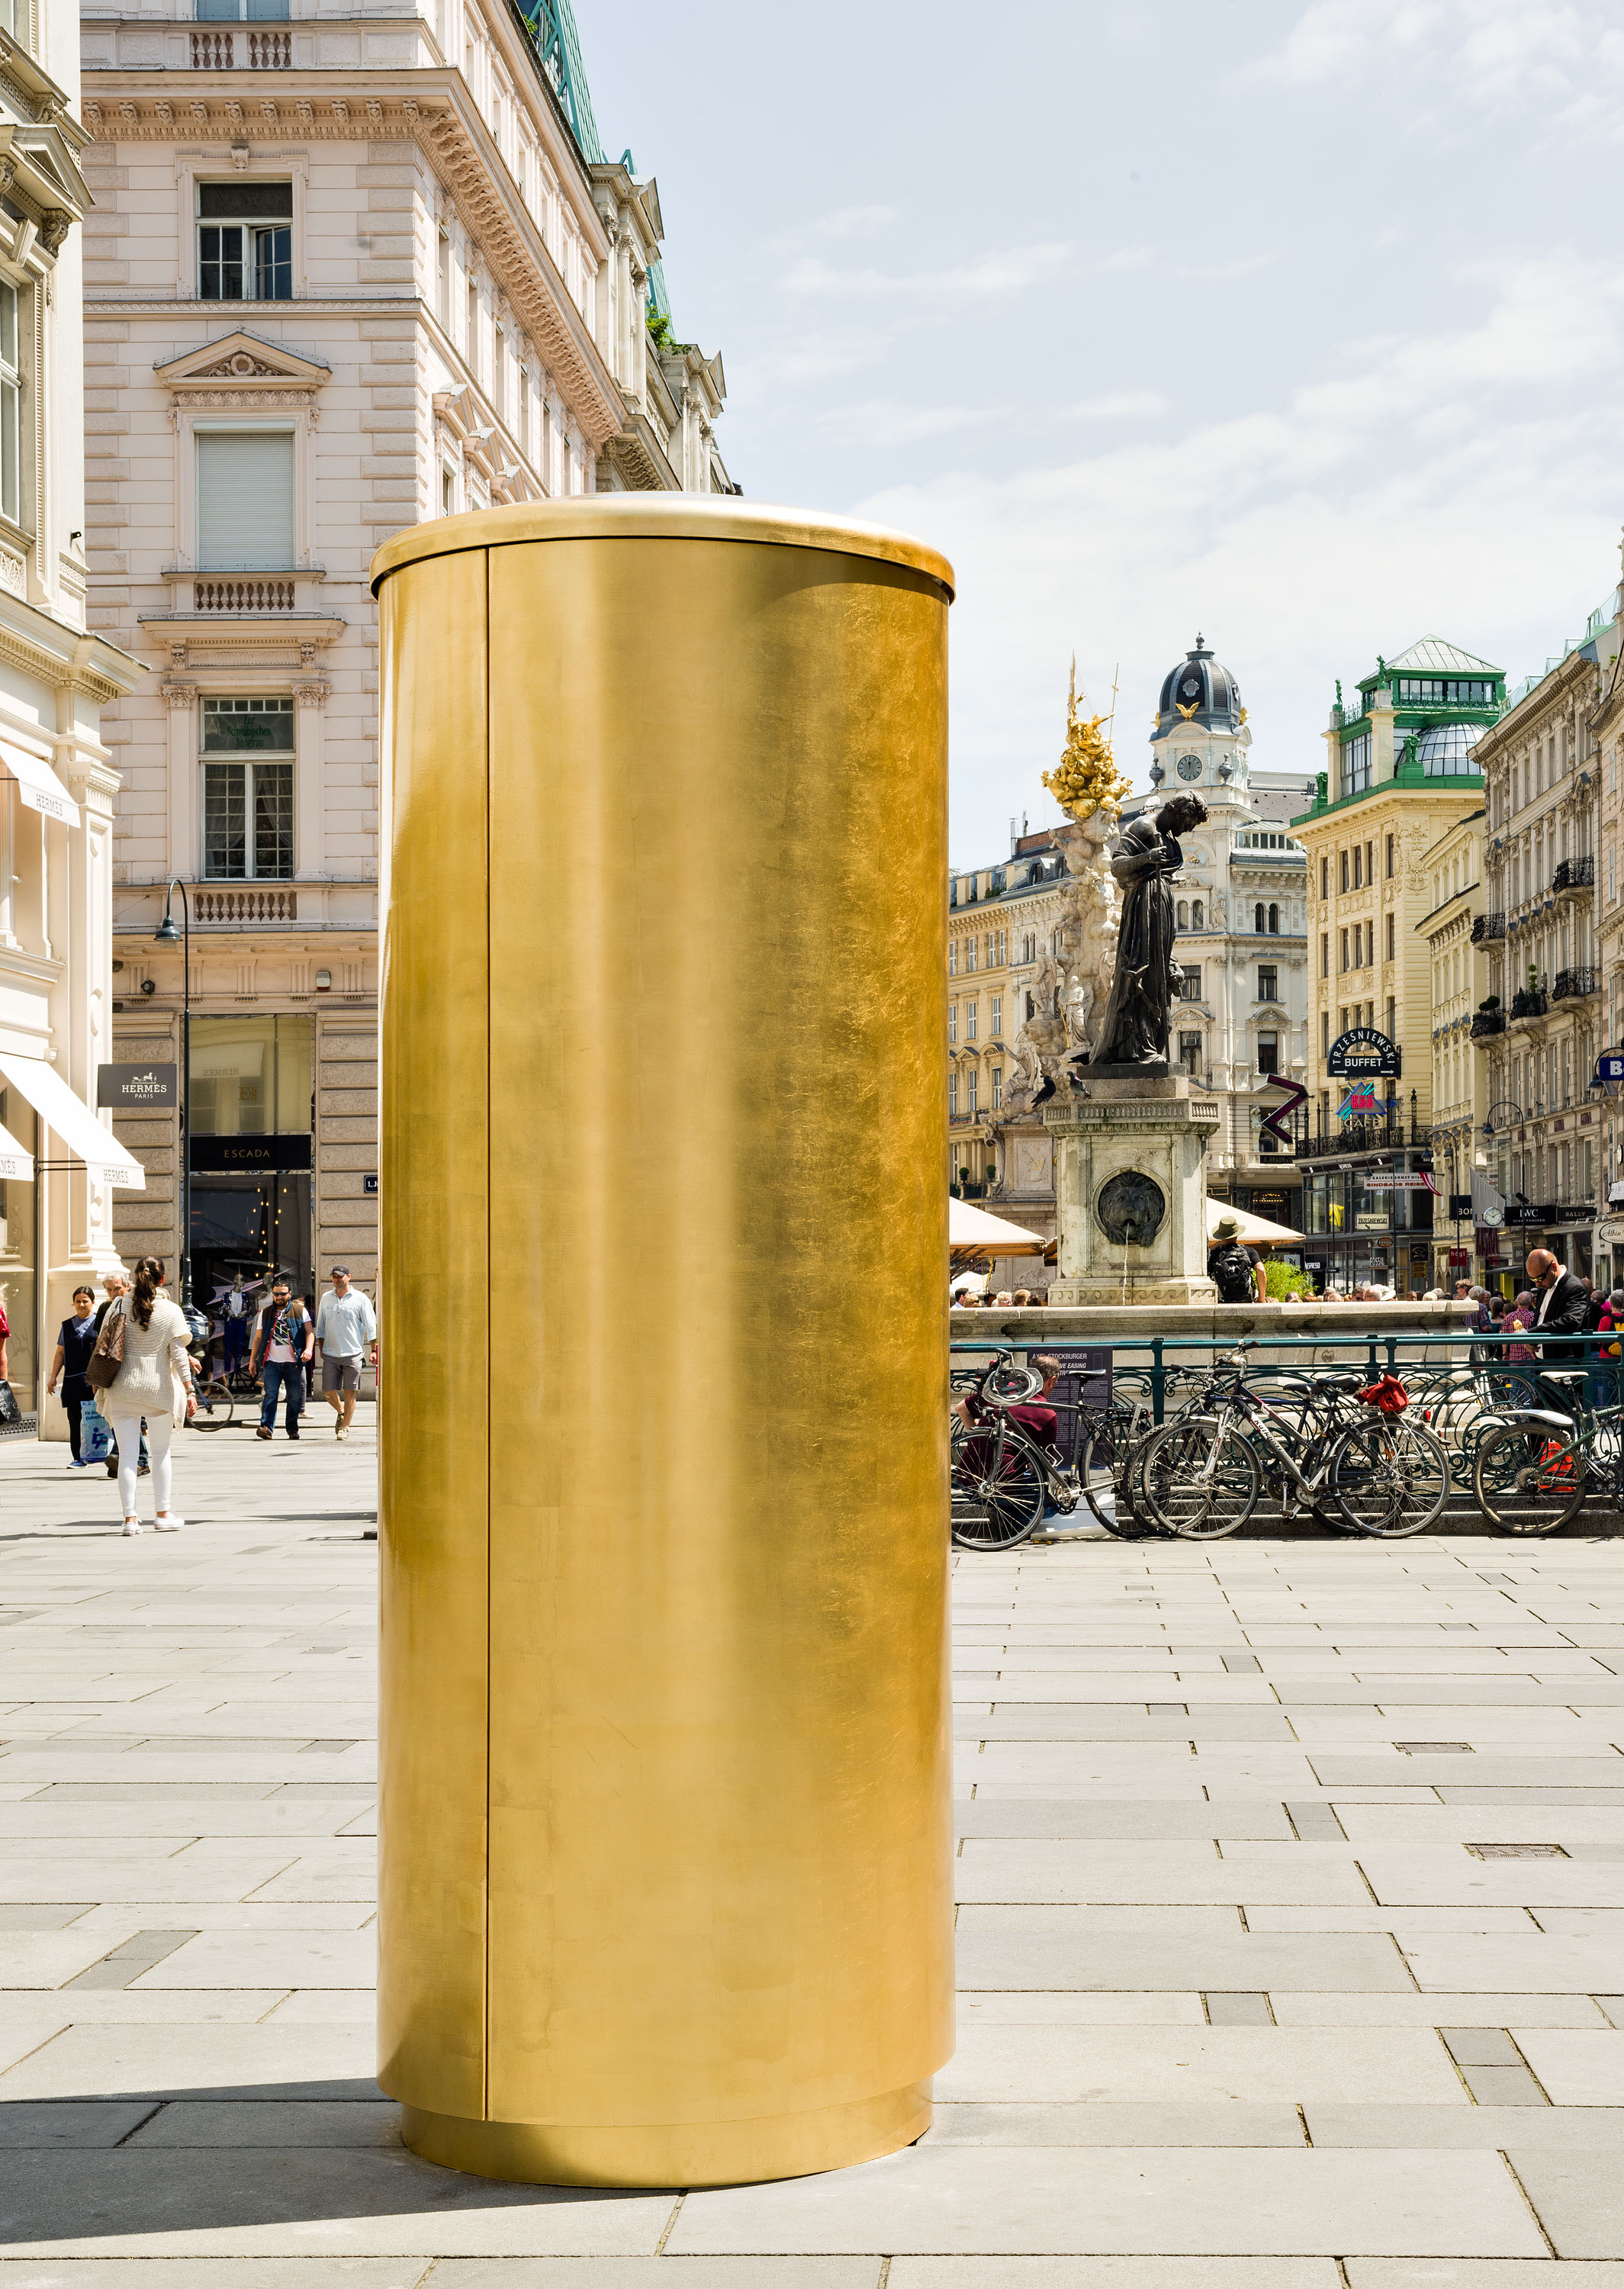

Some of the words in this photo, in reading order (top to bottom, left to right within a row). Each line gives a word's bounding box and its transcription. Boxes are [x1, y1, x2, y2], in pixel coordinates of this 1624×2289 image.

[1344, 1058, 1383, 1067] BUFFET
[1610, 1061, 1624, 1076] B
[121, 1083, 167, 1093] HERMÈS
[1351, 1095, 1374, 1109] Köö
[224, 1149, 270, 1158] ESCADA
[1519, 1209, 1539, 1218] IWC
[1370, 1257, 1384, 1266] FOSSIL
